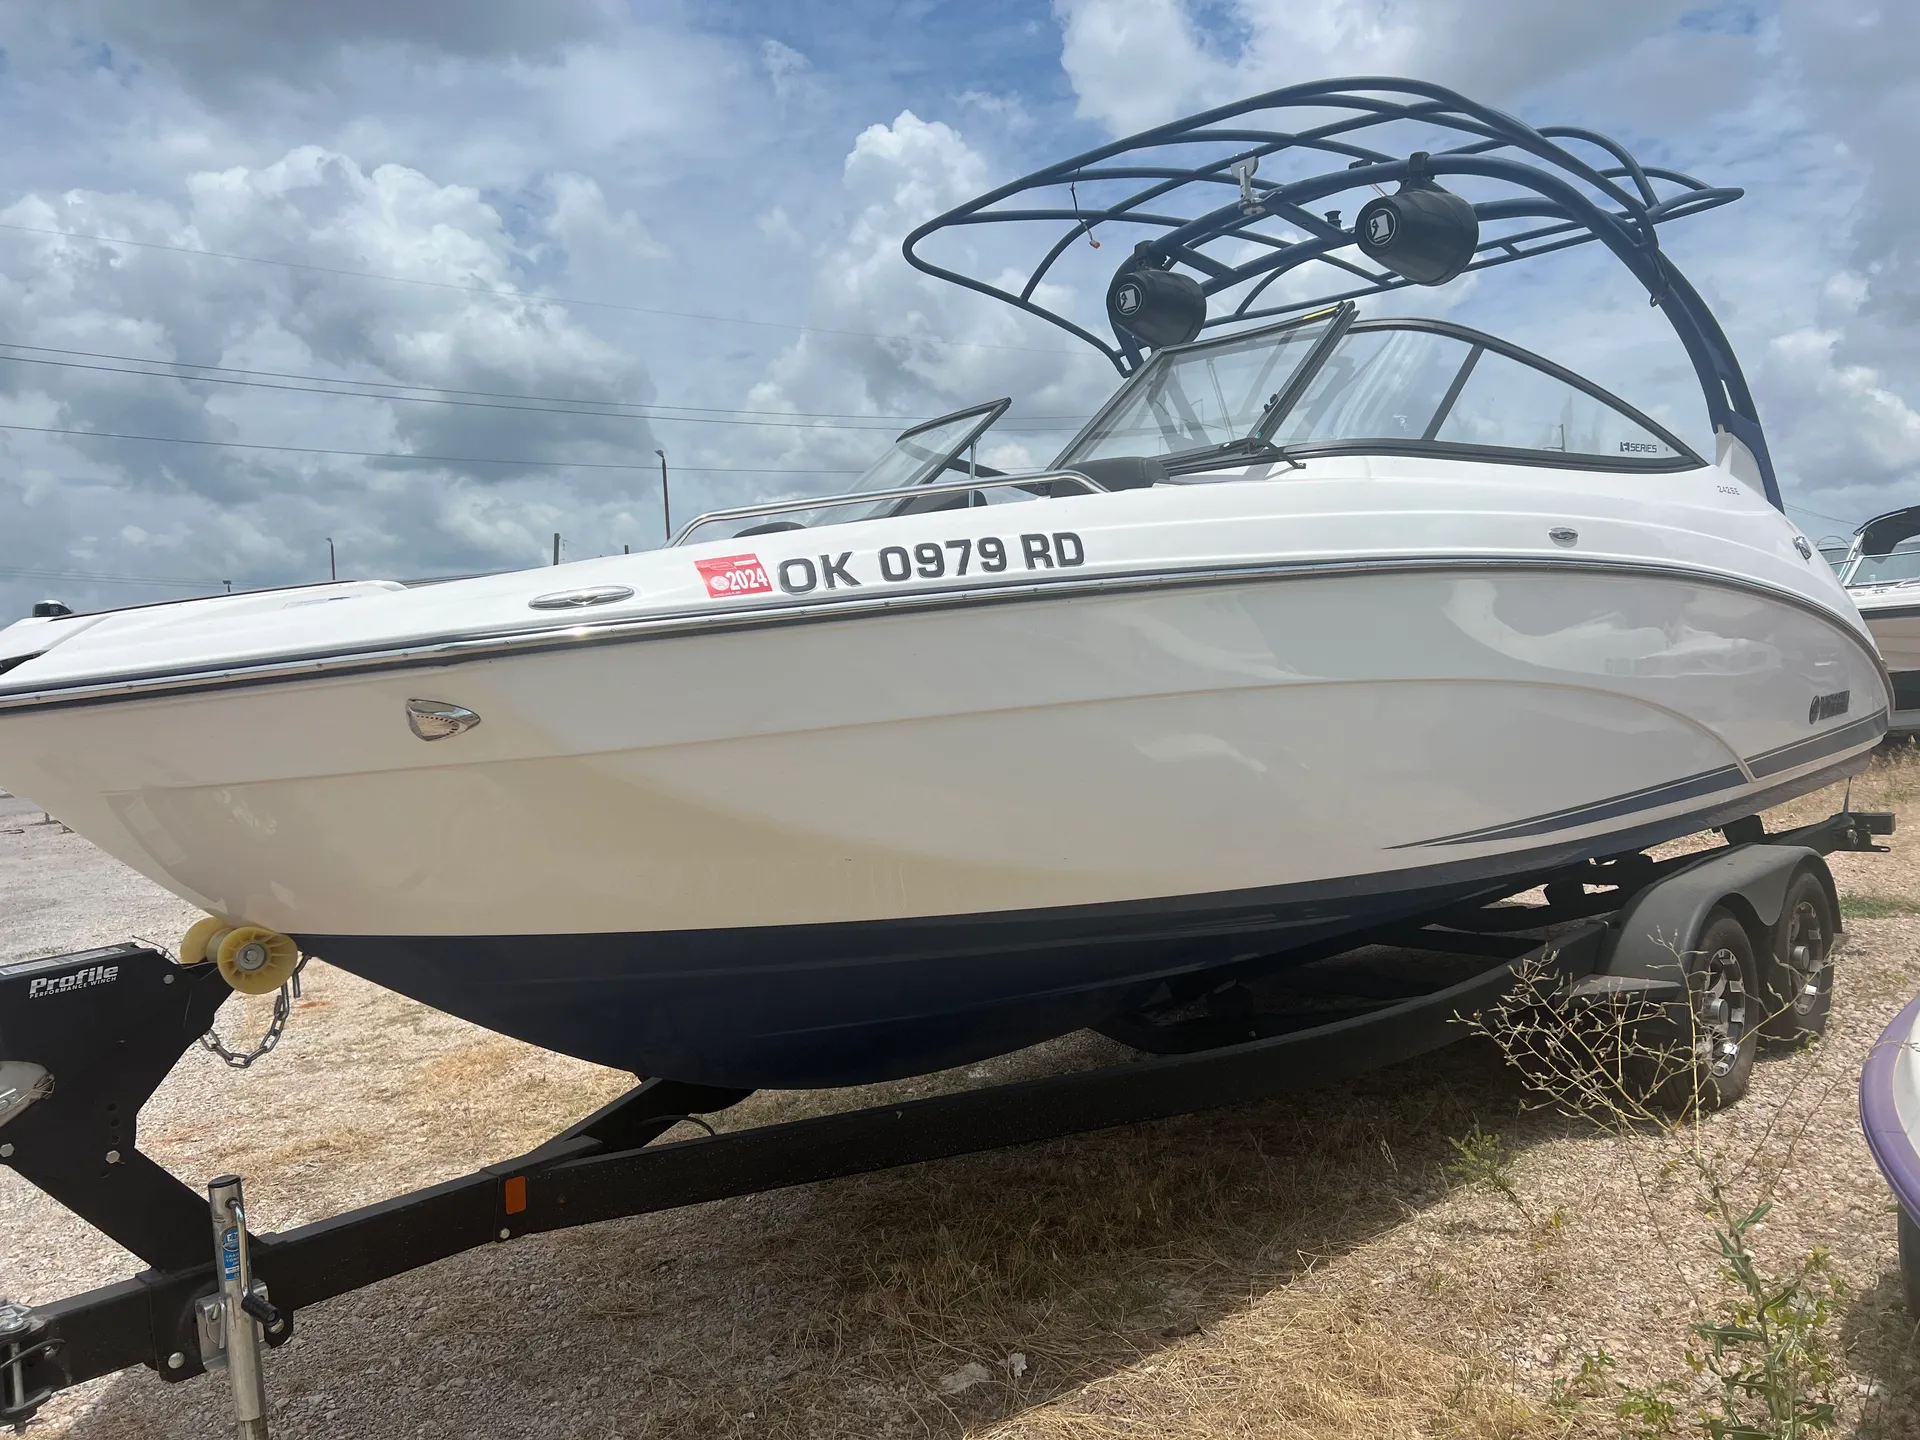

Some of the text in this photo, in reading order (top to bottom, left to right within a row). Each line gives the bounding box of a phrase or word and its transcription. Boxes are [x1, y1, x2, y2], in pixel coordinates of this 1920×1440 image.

[777, 531, 1087, 595] OK 0979 RD
[725, 567, 769, 591] 2024
[29, 965, 119, 995] Profile
[29, 976, 117, 999] PERFORMANCE WINCH
